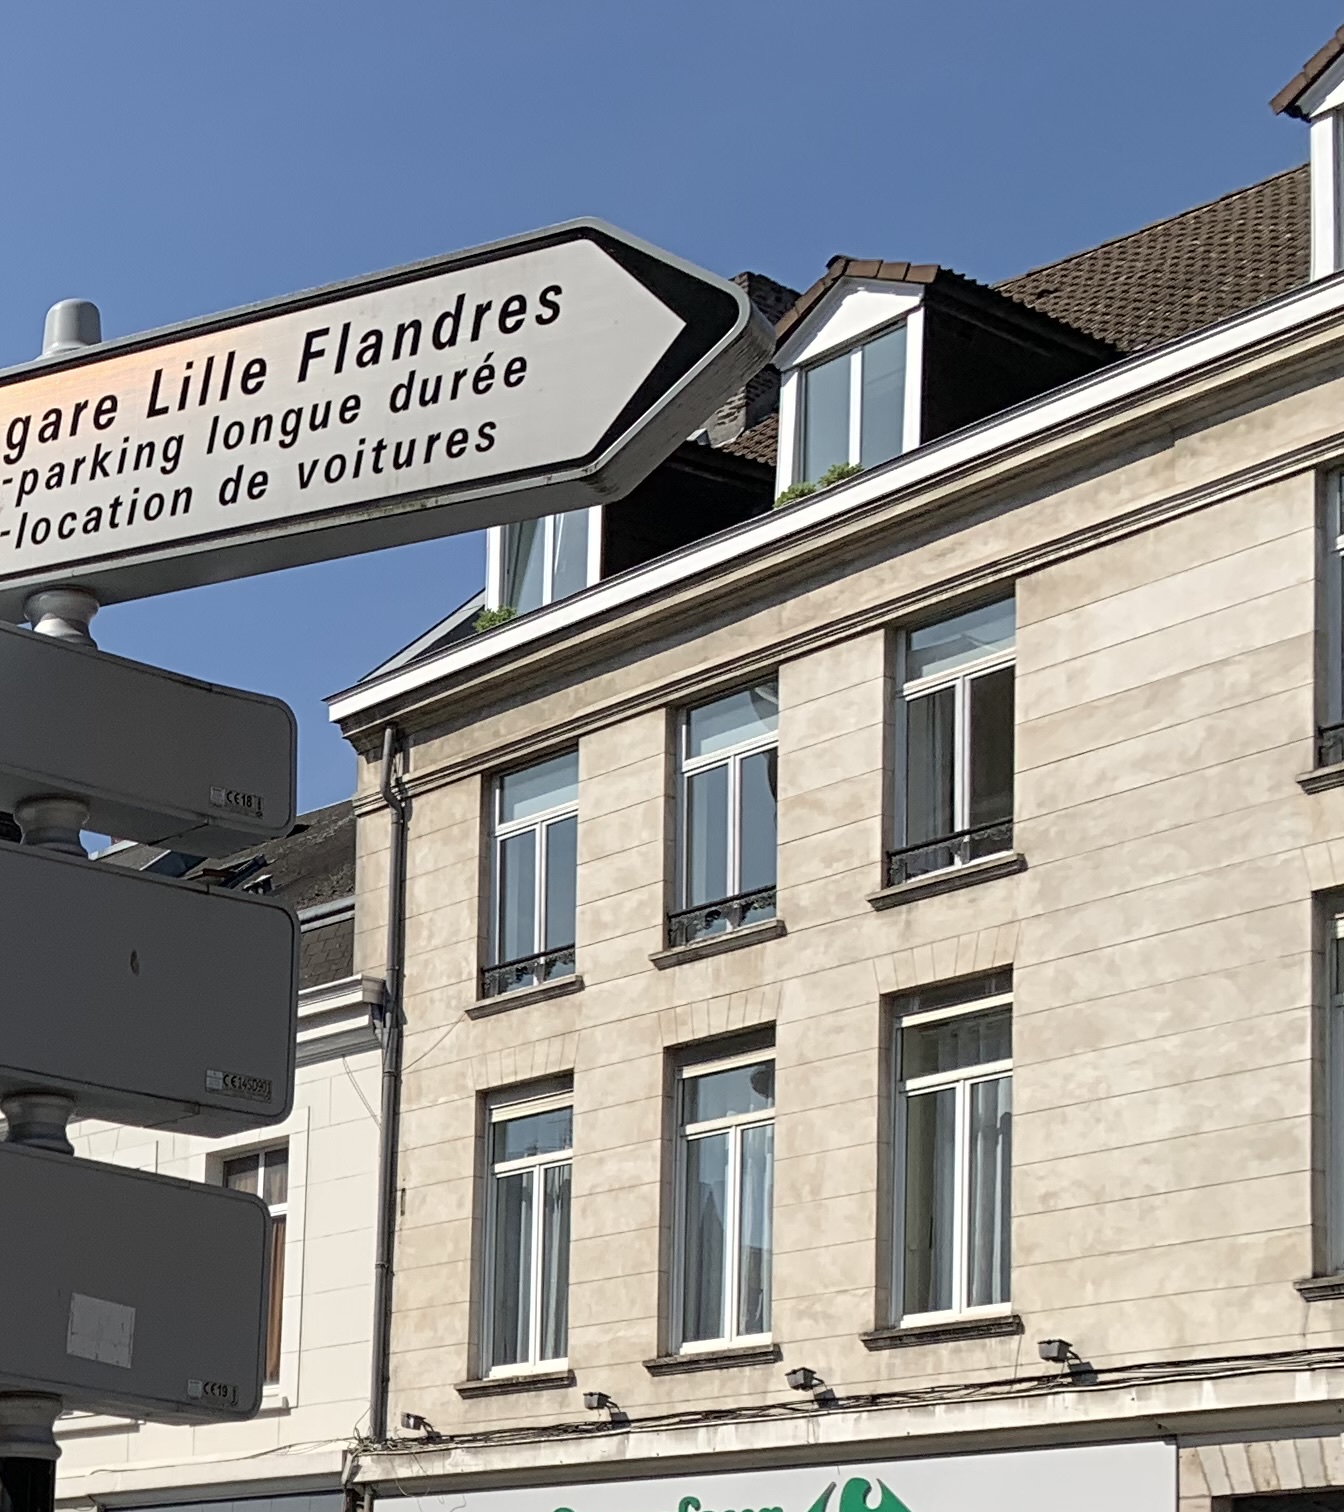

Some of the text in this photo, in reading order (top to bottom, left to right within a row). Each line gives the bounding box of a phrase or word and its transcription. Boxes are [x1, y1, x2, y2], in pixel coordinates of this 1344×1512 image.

[1, 352, 528, 506] -parking longue durée
[3, 280, 563, 464] gare Lille Flandres
[0, 417, 497, 549] -location de voitures
